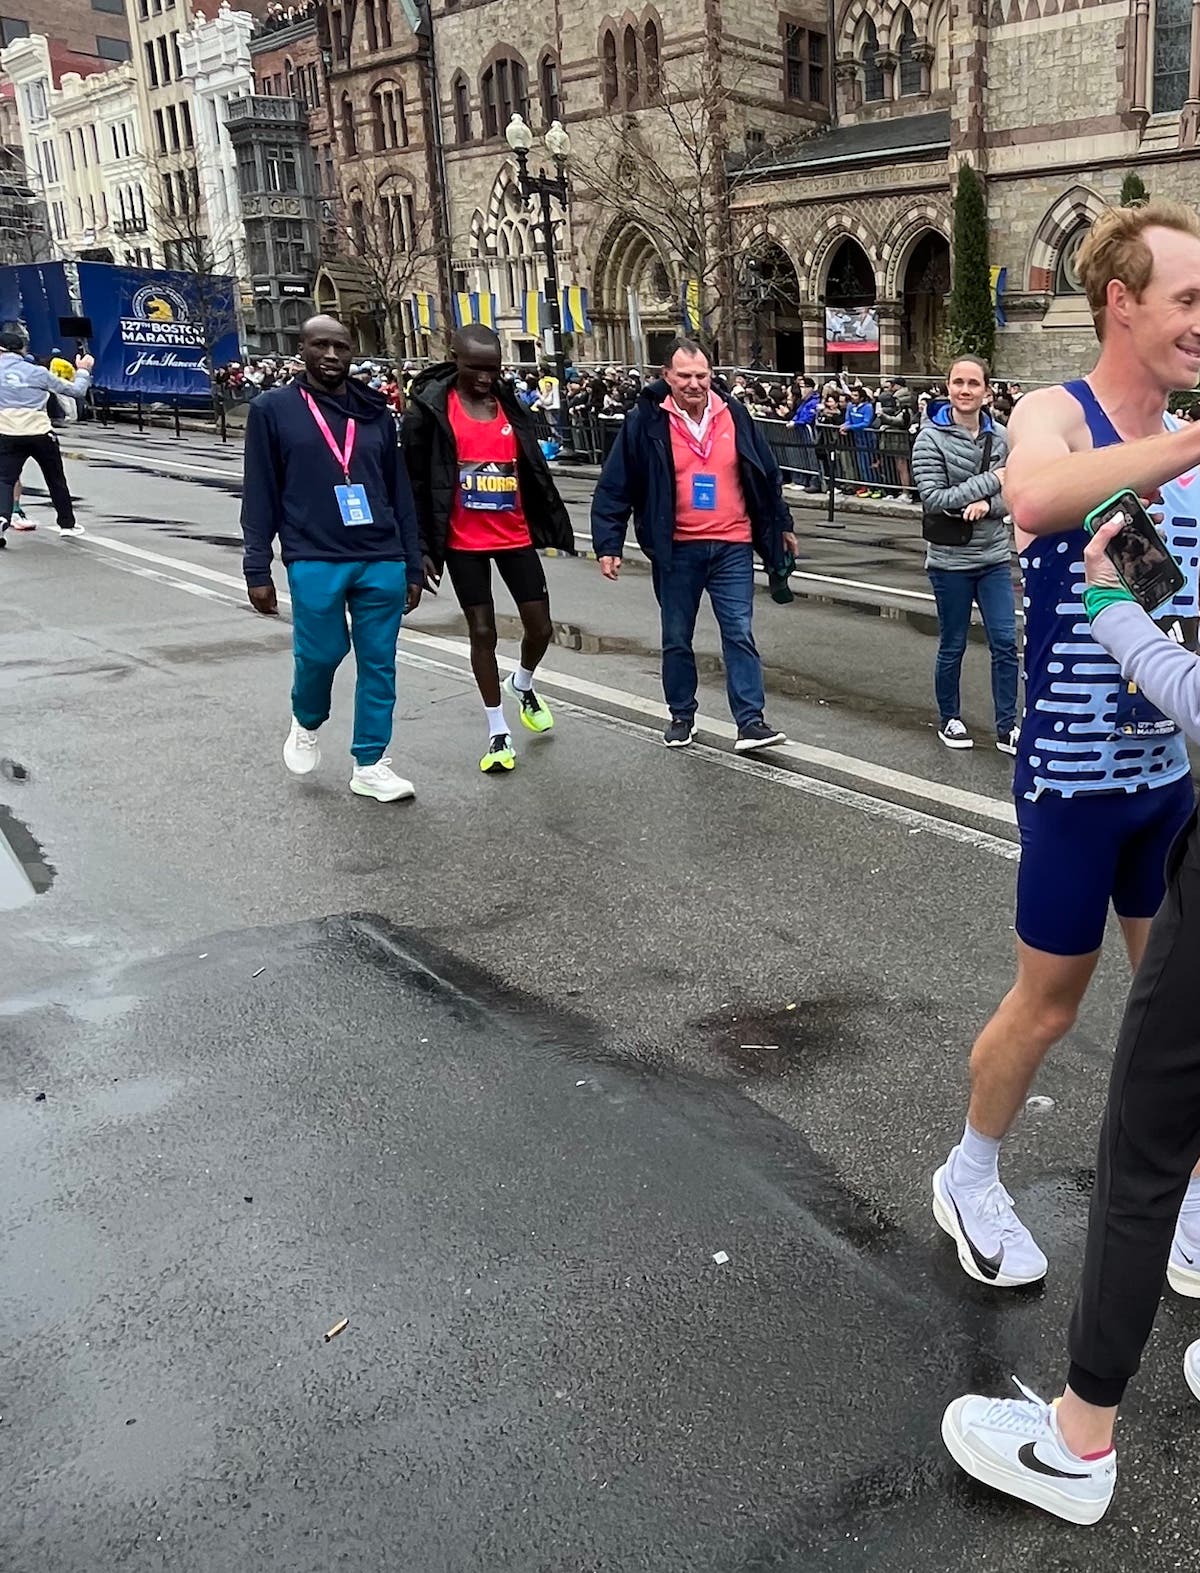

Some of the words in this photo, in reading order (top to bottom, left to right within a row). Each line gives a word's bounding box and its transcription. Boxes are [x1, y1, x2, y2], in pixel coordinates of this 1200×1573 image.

[121, 331, 206, 345] MARATHON
[125, 351, 160, 376] John
[461, 475, 472, 490] J
